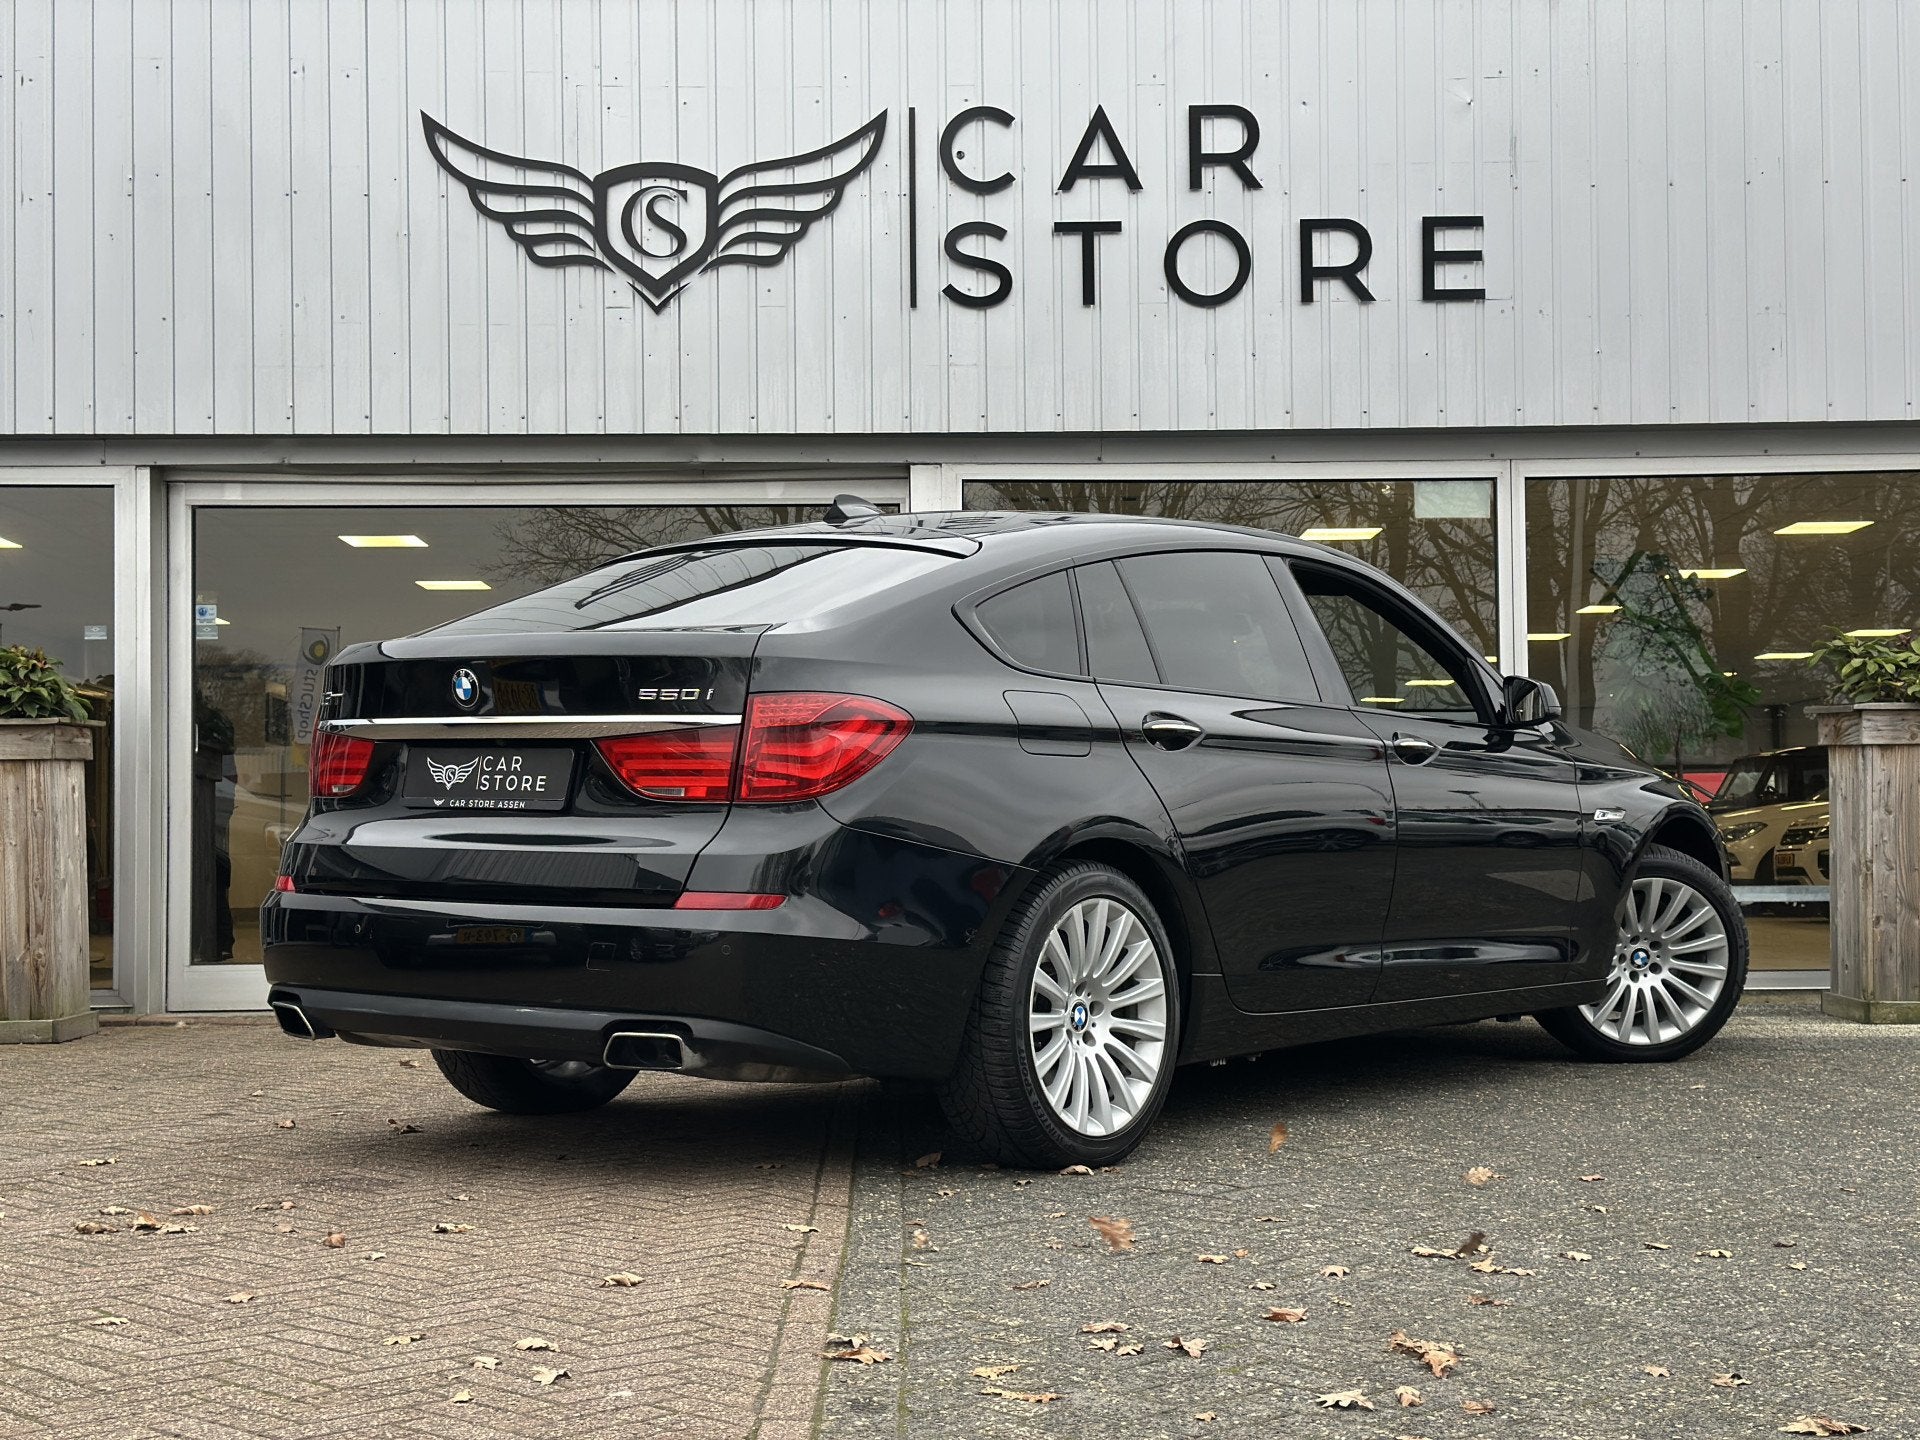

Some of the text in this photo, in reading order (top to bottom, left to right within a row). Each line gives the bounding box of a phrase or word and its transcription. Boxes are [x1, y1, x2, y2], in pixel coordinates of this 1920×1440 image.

[939, 104, 1264, 197] CAR
[941, 215, 1486, 311] STORE
[482, 755, 523, 772] CAR
[479, 774, 547, 792] STORE
[449, 799, 526, 809] CAR STORE ASSEN
